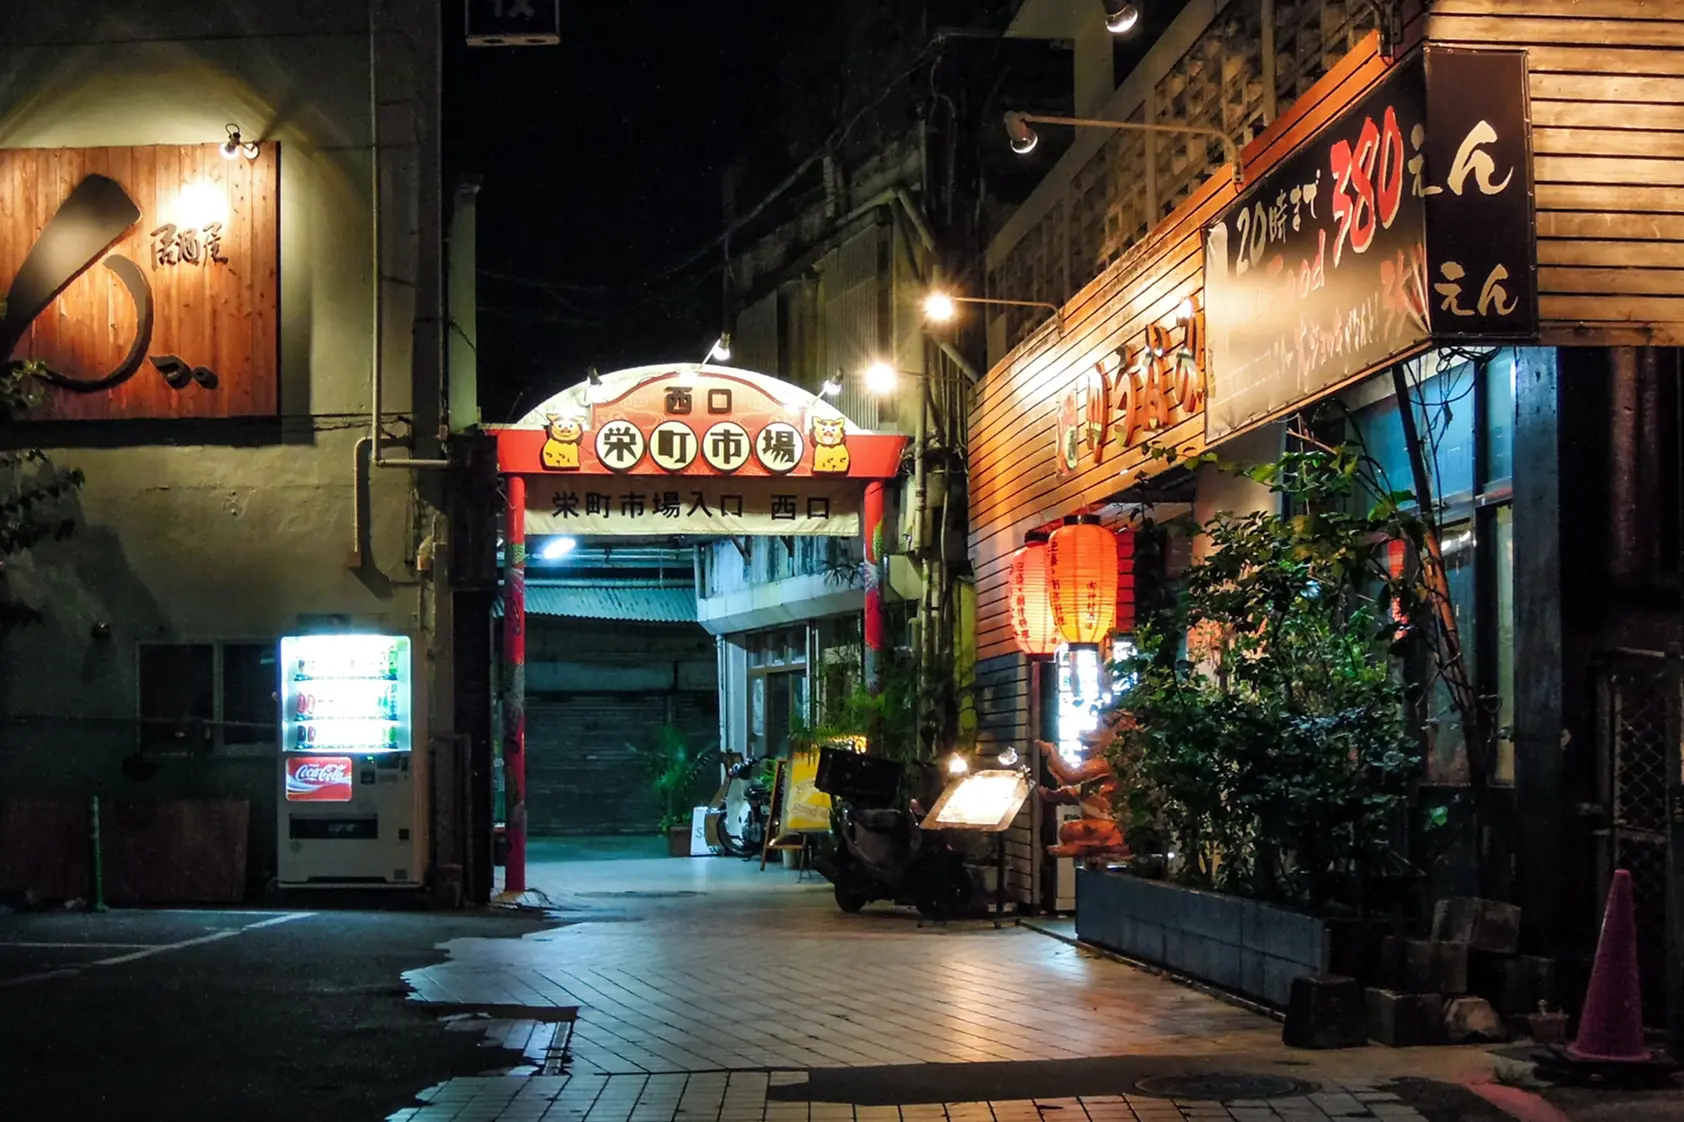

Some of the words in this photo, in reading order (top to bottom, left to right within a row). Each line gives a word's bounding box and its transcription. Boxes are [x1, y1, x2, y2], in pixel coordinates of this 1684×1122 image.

[150, 221, 229, 271] 居酒屋
[663, 386, 733, 415] 西口
[602, 427, 798, 467] 栄町市場
[552, 491, 744, 520] 栄町市場入口
[770, 493, 831, 521] 西口
